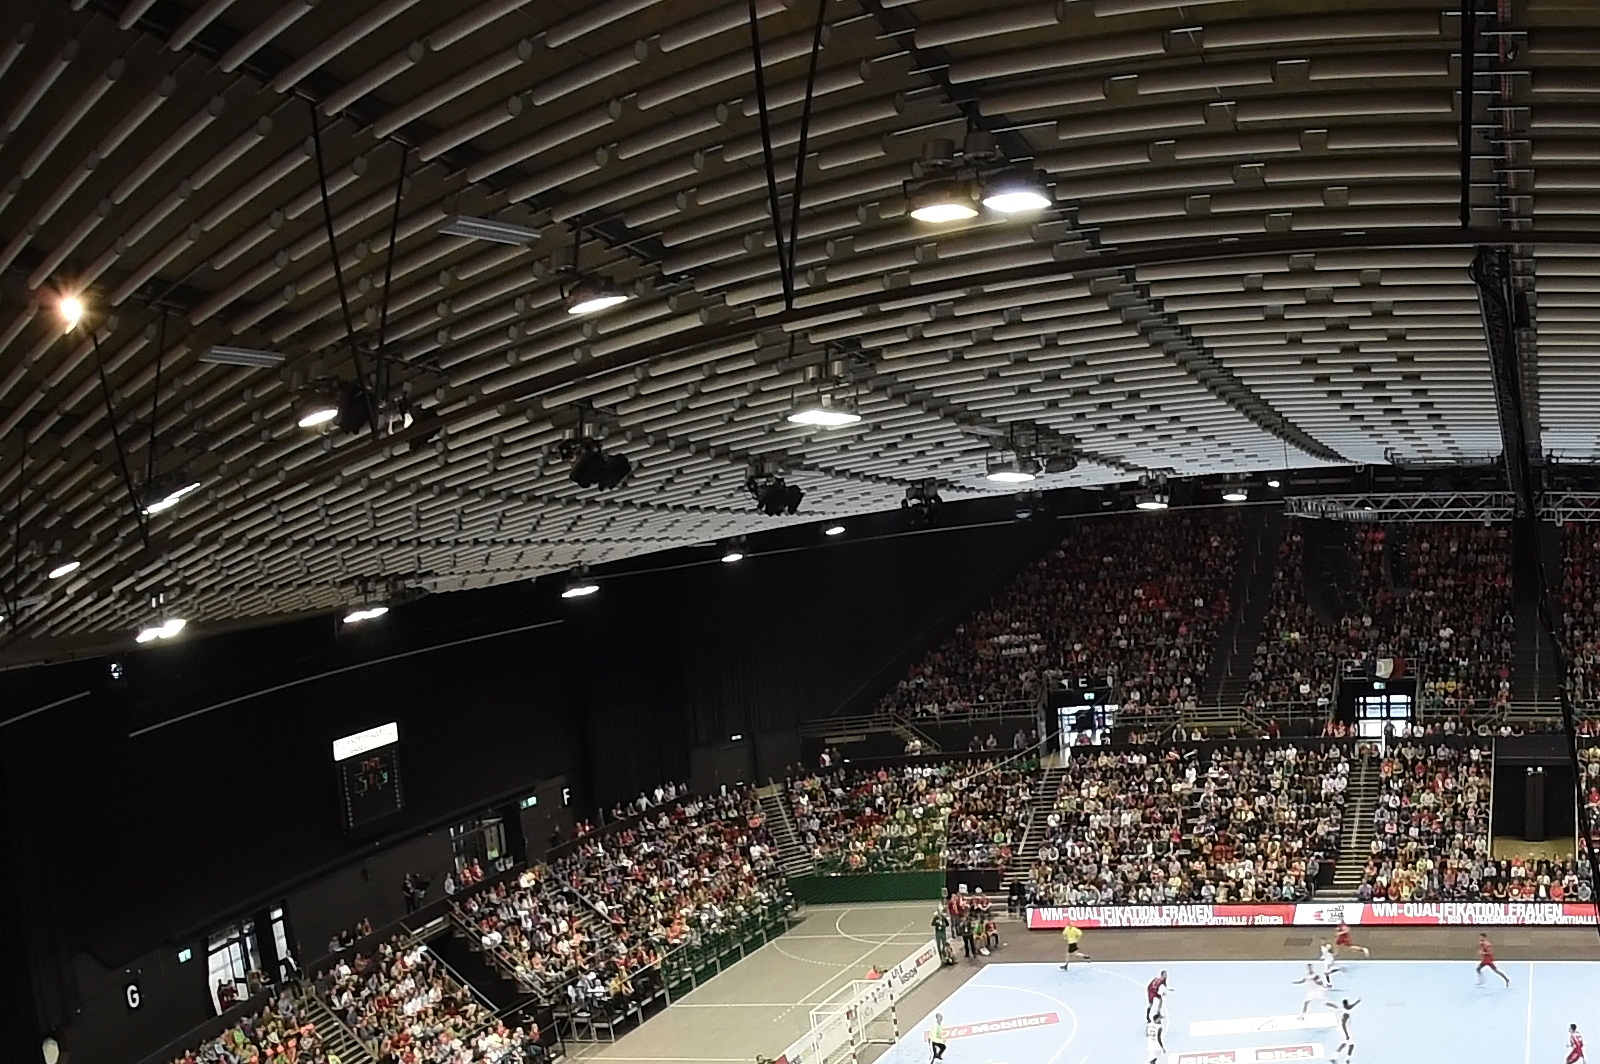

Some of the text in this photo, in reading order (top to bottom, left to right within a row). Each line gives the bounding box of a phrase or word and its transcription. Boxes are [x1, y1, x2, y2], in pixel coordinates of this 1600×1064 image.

[562, 787, 571, 806] F
[1040, 904, 1213, 922] WM-QUALIFIKATION FRAUEN
[1372, 903, 1563, 919] WM-QUALIFIKATION FRAUEN
[126, 984, 140, 1009] G
[971, 1015, 1049, 1034] Mobiliar
